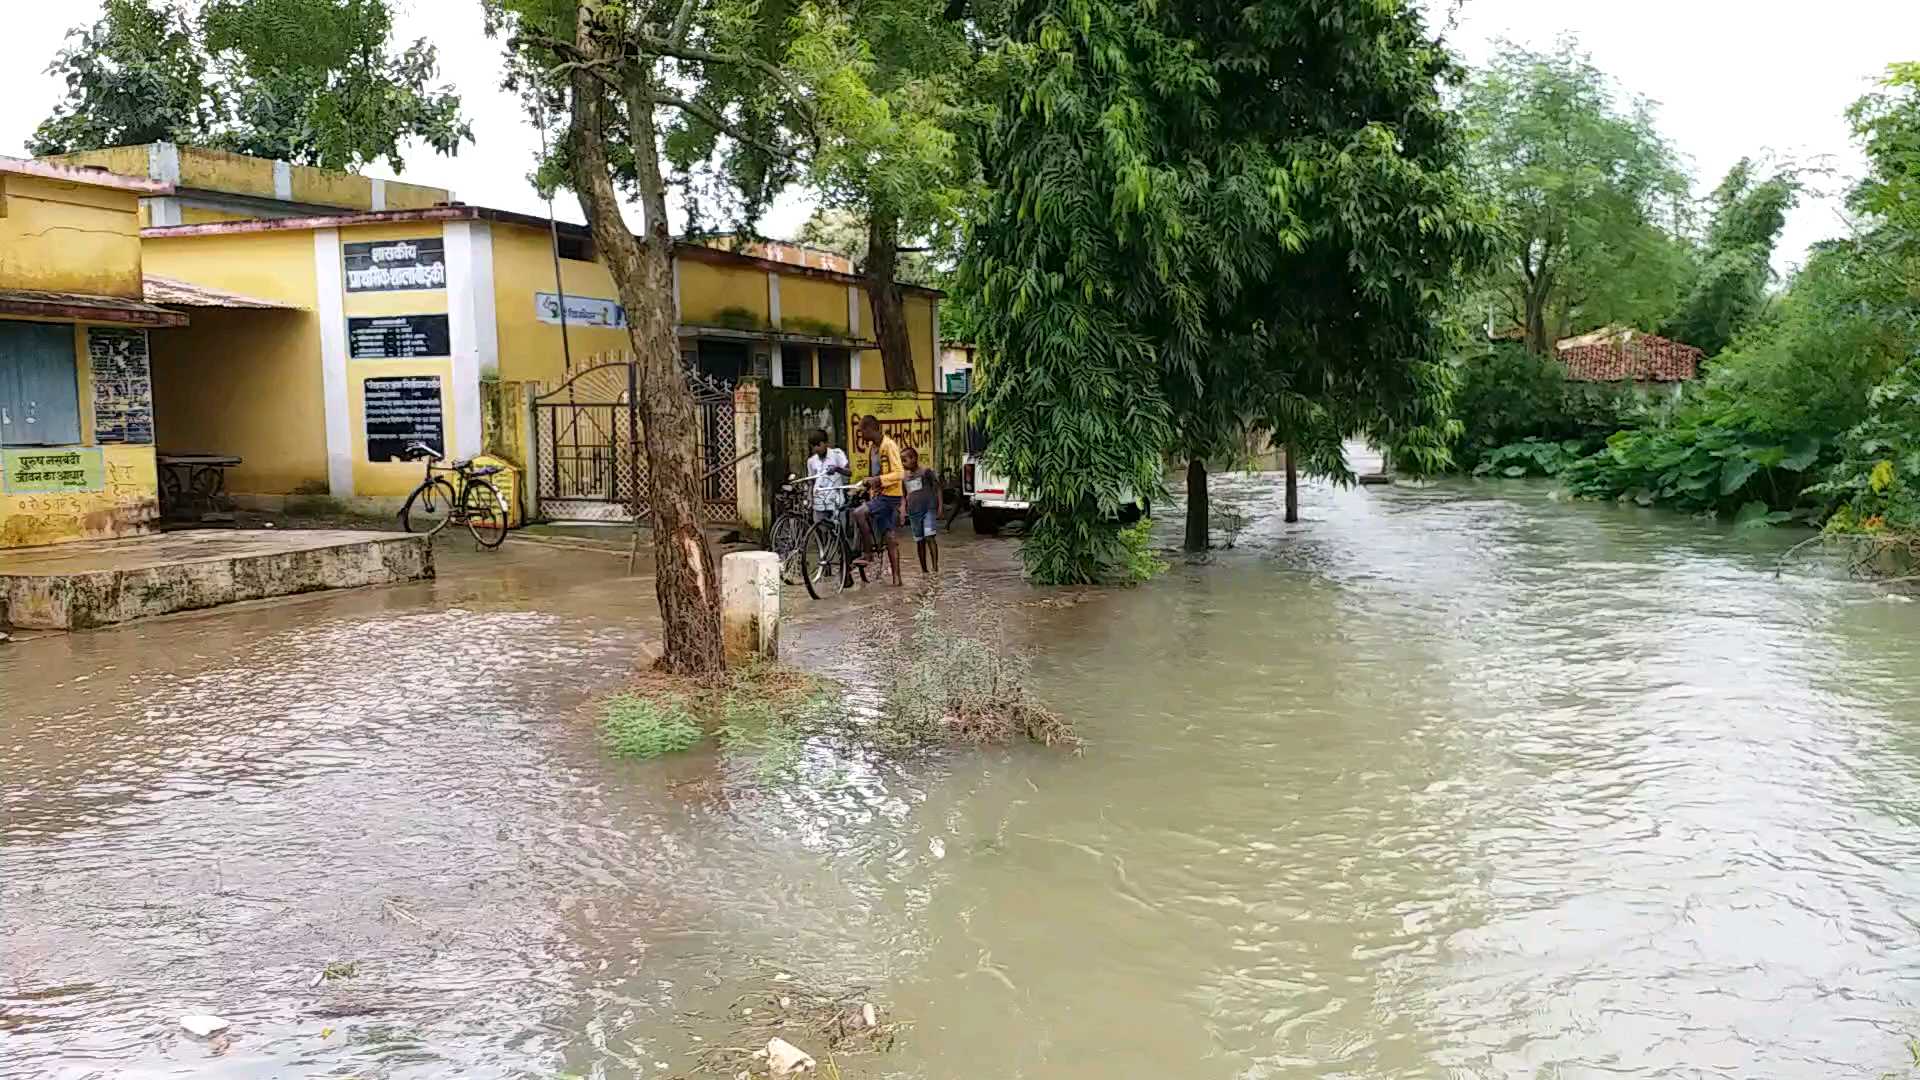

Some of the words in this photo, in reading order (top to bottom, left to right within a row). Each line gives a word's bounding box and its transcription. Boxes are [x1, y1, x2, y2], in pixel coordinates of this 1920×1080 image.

[371, 242, 416, 262] शासकीय
[18, 456, 45, 470] पुरुष
[14, 470, 42, 482] जीवन
[43, 471, 56, 480] का
[57, 470, 85, 481] आधार
